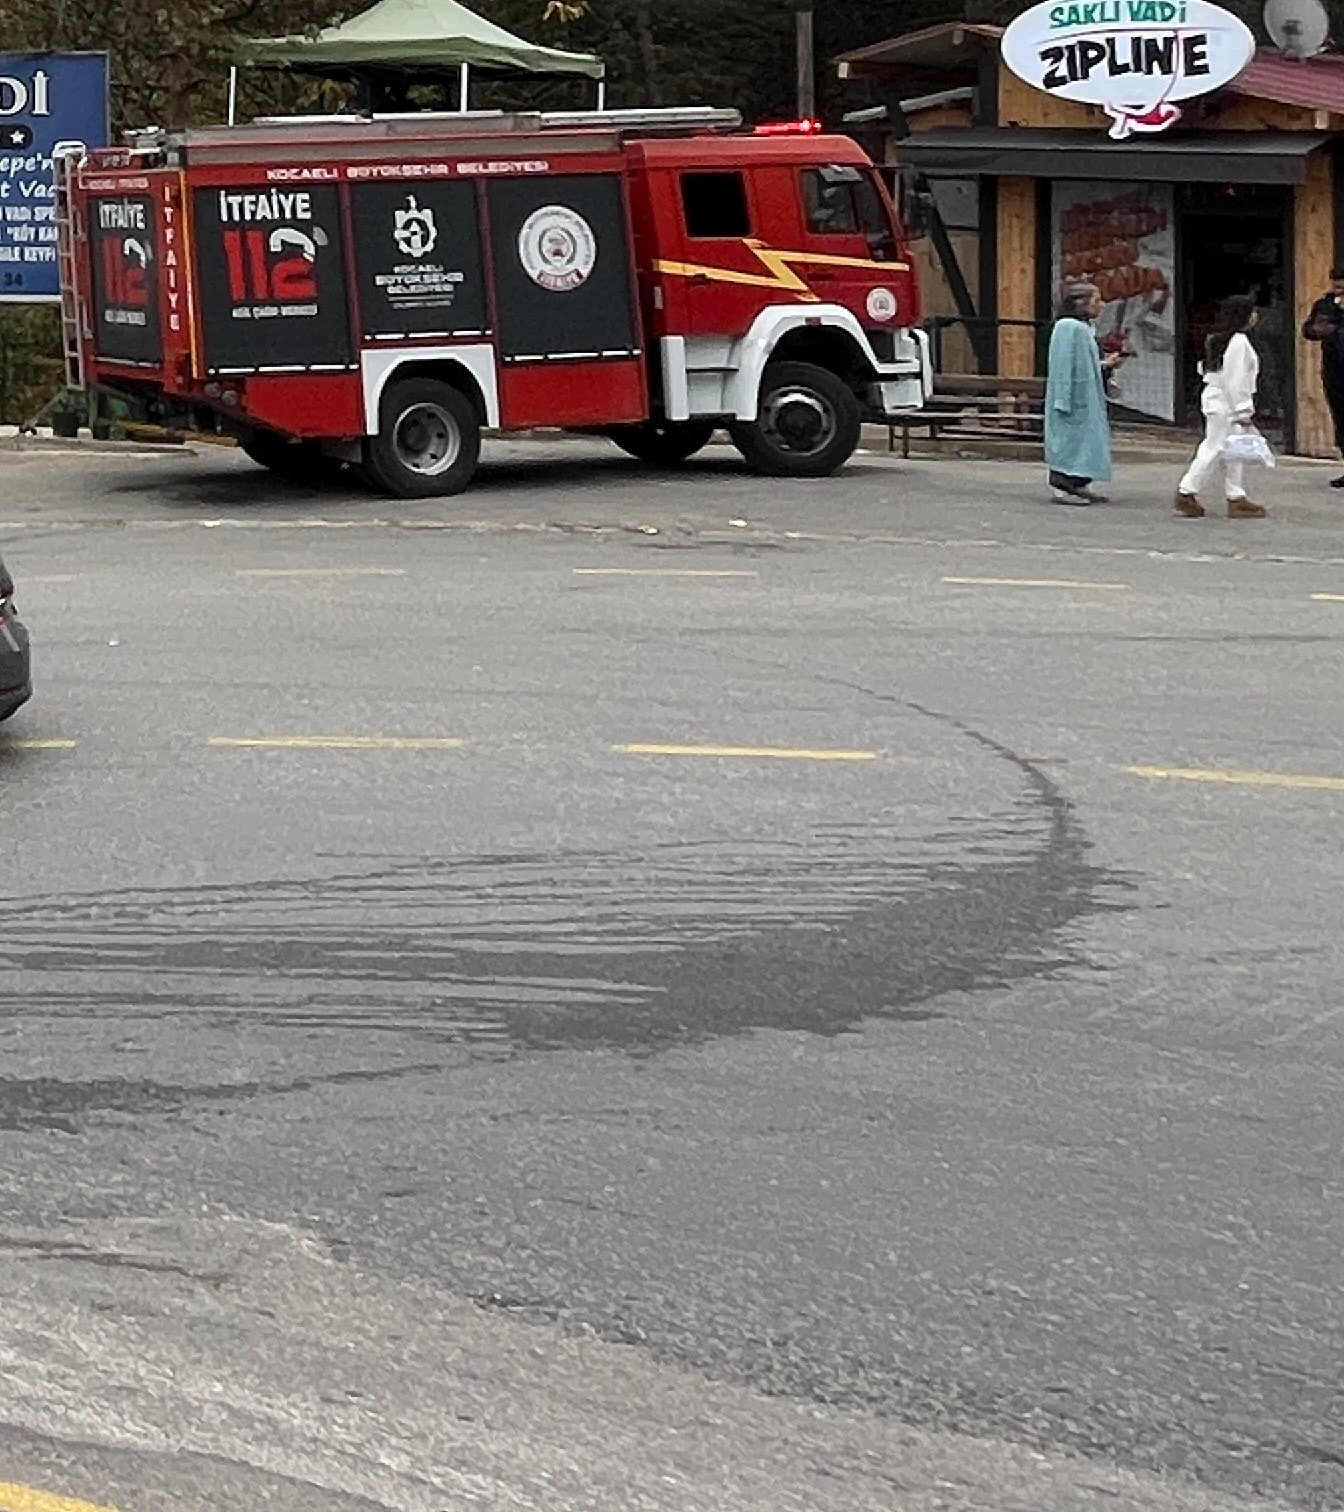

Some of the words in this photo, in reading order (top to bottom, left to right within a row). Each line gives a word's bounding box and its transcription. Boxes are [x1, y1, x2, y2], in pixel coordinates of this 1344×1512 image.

[1049, 1, 1121, 29] SAKLI
[1039, 34, 1210, 89] ZIPLINE
[219, 188, 313, 222] İTFAİYE
